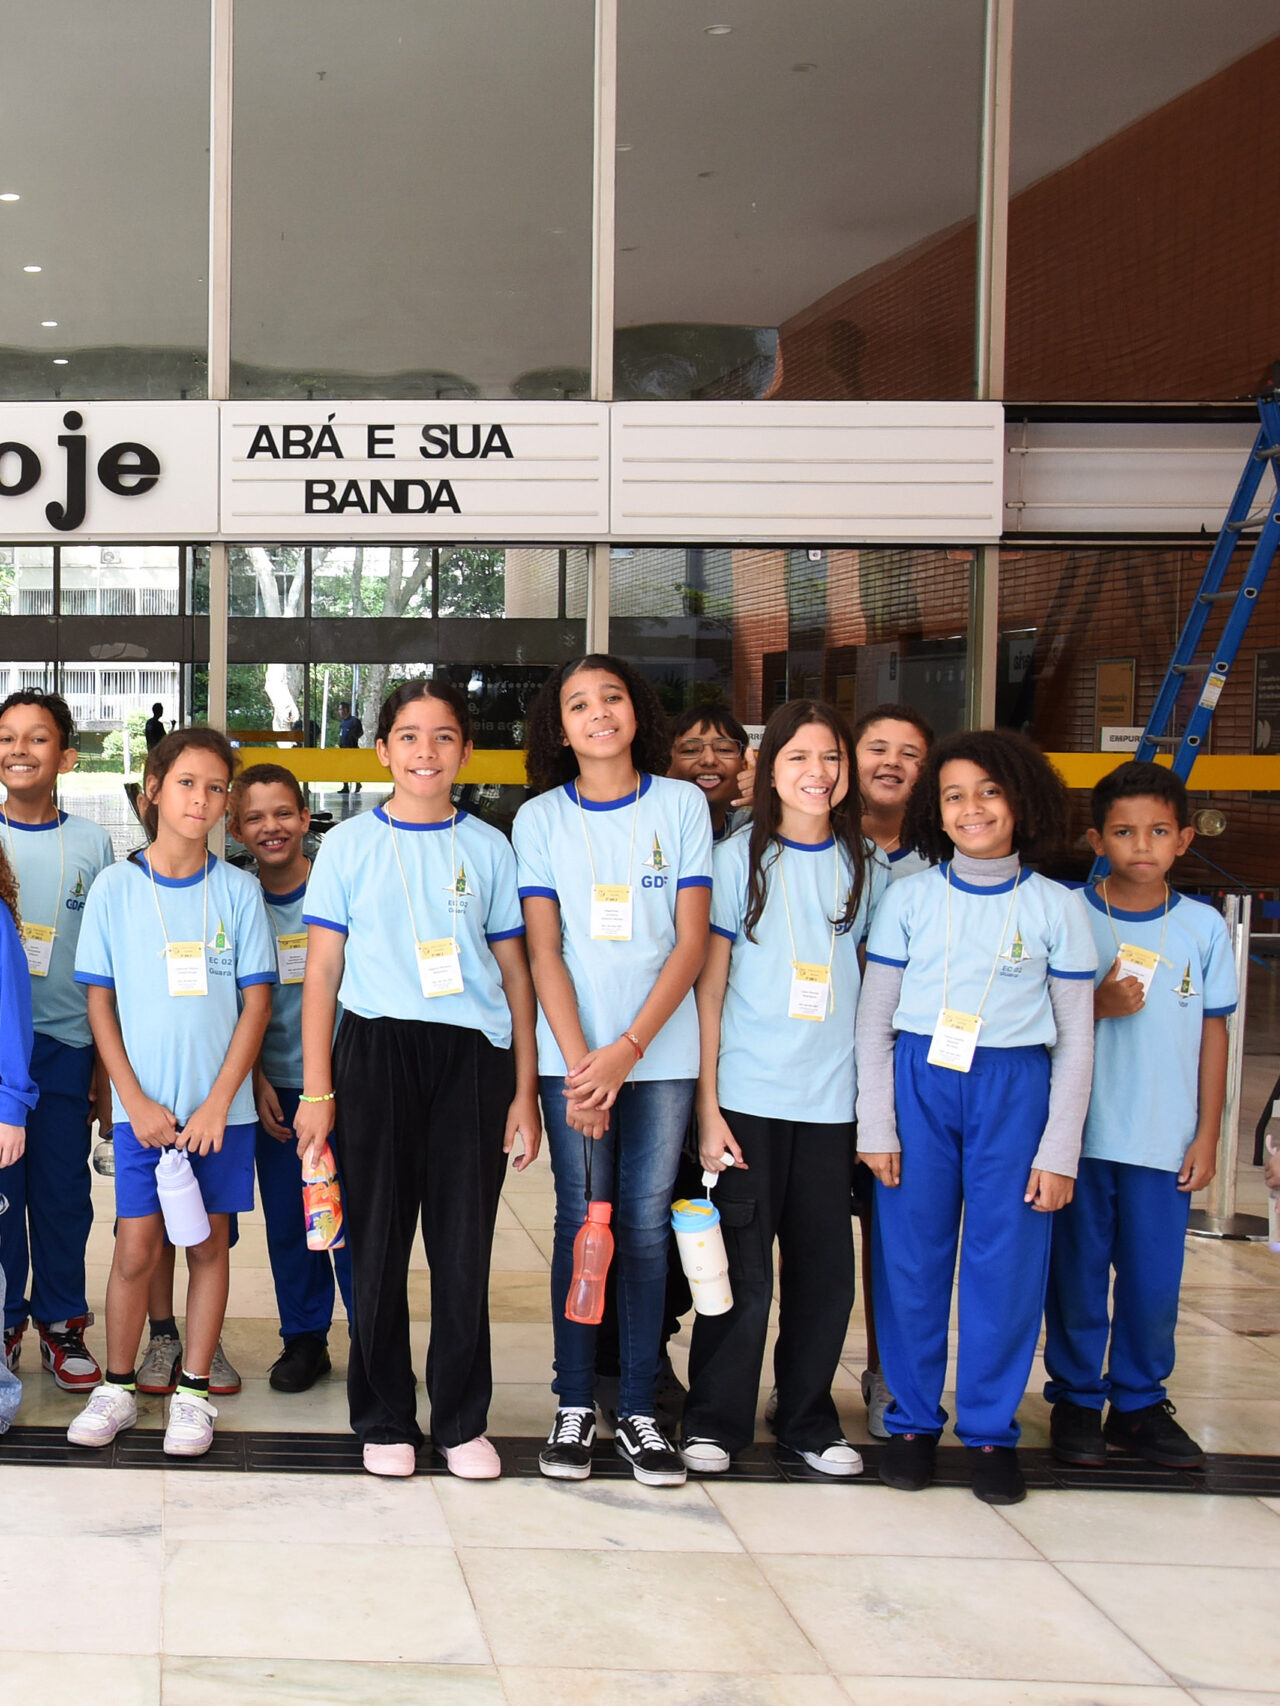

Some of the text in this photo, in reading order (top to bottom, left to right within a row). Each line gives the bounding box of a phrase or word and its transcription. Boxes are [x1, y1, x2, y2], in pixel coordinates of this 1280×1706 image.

[246, 412, 514, 459] ABÁ E SUA
[304, 479, 462, 514] BANDA
[1109, 734, 1142, 743] EMPUR
[66, 898, 86, 911] GDF
[209, 956, 233, 966] EC 02
